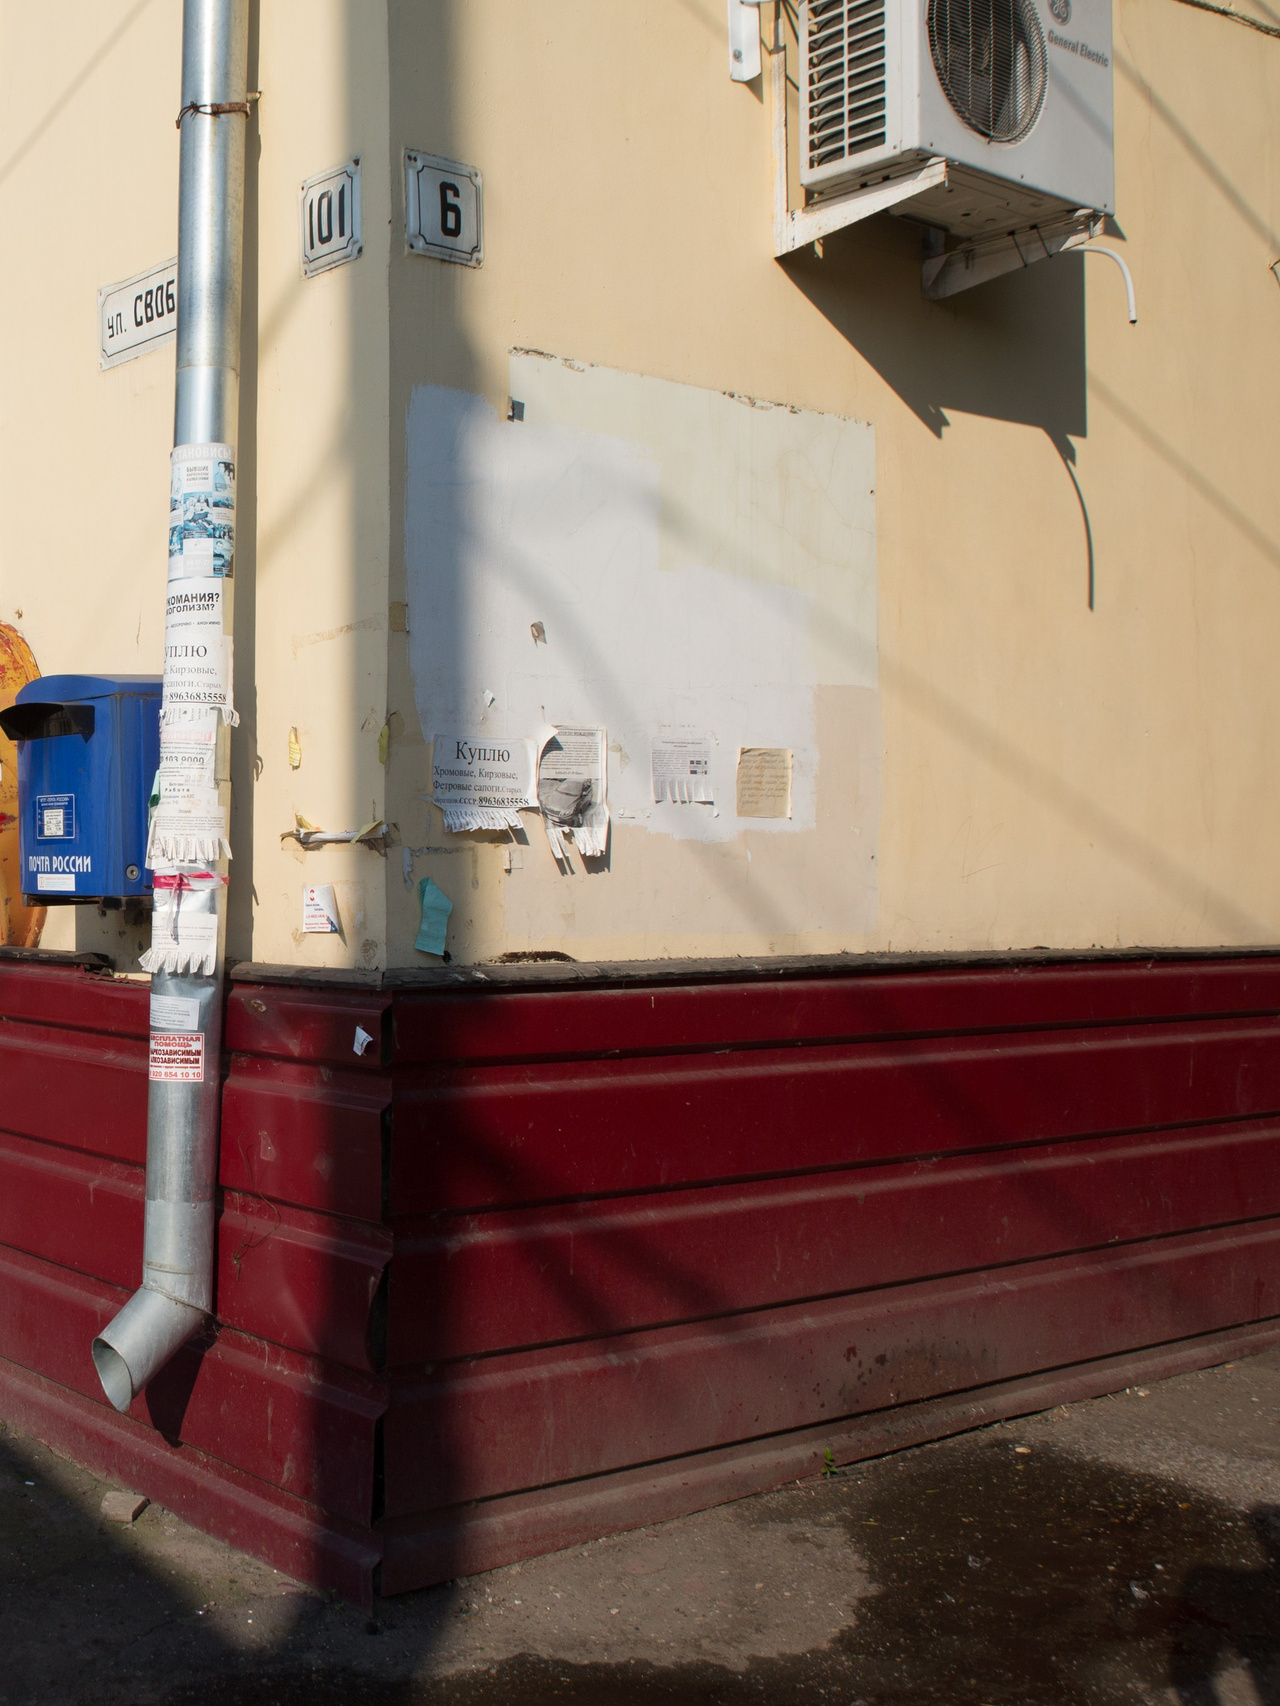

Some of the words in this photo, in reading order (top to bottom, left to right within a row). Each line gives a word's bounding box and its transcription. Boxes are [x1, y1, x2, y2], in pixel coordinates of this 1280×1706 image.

[1047, 30, 1079, 54] General
[1080, 43, 1109, 68] Electric
[308, 183, 346, 251] 101
[439, 180, 462, 239] 6
[133, 278, 176, 328] СВОБ
[173, 446, 232, 462] СТАНОВИСЬ!
[455, 741, 511, 765] Куплю
[433, 765, 477, 778] Хромовые,
[478, 768, 518, 780] Кирзовые,
[433, 781, 472, 792] Фетровые
[28, 855, 51, 872] ПОЧТА
[52, 855, 92, 873] РОССИИ
